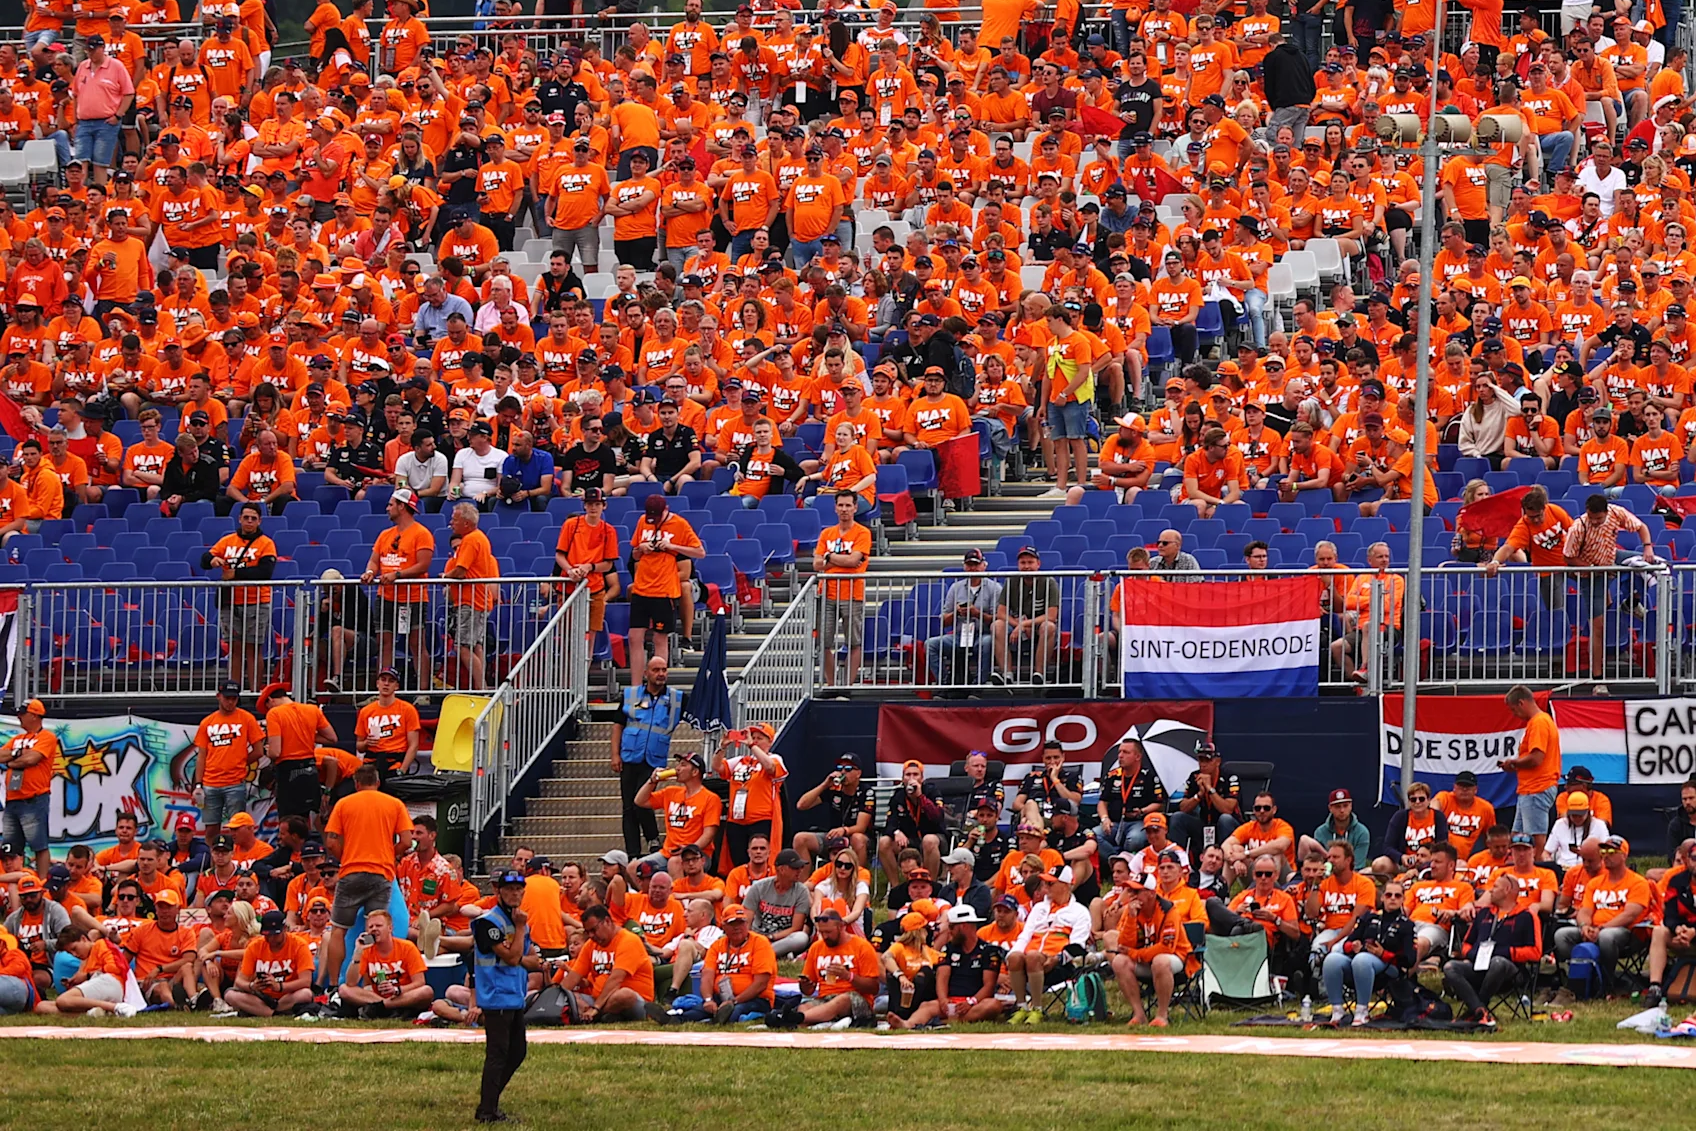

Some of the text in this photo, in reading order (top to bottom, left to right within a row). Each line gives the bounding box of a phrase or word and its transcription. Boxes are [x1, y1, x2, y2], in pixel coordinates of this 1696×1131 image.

[1244, 23, 1268, 35] MAX
[769, 44, 794, 53] MAX
[207, 50, 234, 62] MAX
[1191, 53, 1215, 67] MAX
[173, 75, 203, 84] MAX
[14, 92, 39, 103] MAX
[1524, 101, 1551, 110] MAX
[515, 135, 541, 147] MAX
[780, 167, 804, 176] MAX
[483, 172, 507, 184] MAX
[561, 175, 591, 186] MAX
[619, 186, 644, 199] MAX
[732, 182, 760, 194] MAX
[796, 185, 824, 196] MAX
[673, 192, 695, 202] MAX
[163, 202, 189, 212] MAX
[1323, 209, 1350, 222] MAX
[960, 289, 984, 305] MAX
[1159, 293, 1188, 303] MAX
[1510, 319, 1538, 330] MAX
[1562, 314, 1592, 324] MAX
[647, 349, 673, 361] MAX
[772, 385, 800, 402] MAX
[918, 409, 950, 422] MAX
[1587, 451, 1615, 464] MAX
[1642, 449, 1669, 460] MAX
[134, 456, 163, 468] MAX
[1130, 634, 1313, 659] SINT-OEDENRODE
[208, 724, 242, 740] MAX
[992, 714, 1098, 753] GO
[1387, 730, 1521, 761] DOESBUR
[1448, 812, 1480, 828] MAX
[1593, 890, 1628, 905] MAX
[640, 912, 673, 924] MAX
[256, 960, 292, 973] MAX
[817, 956, 854, 968] MAX
